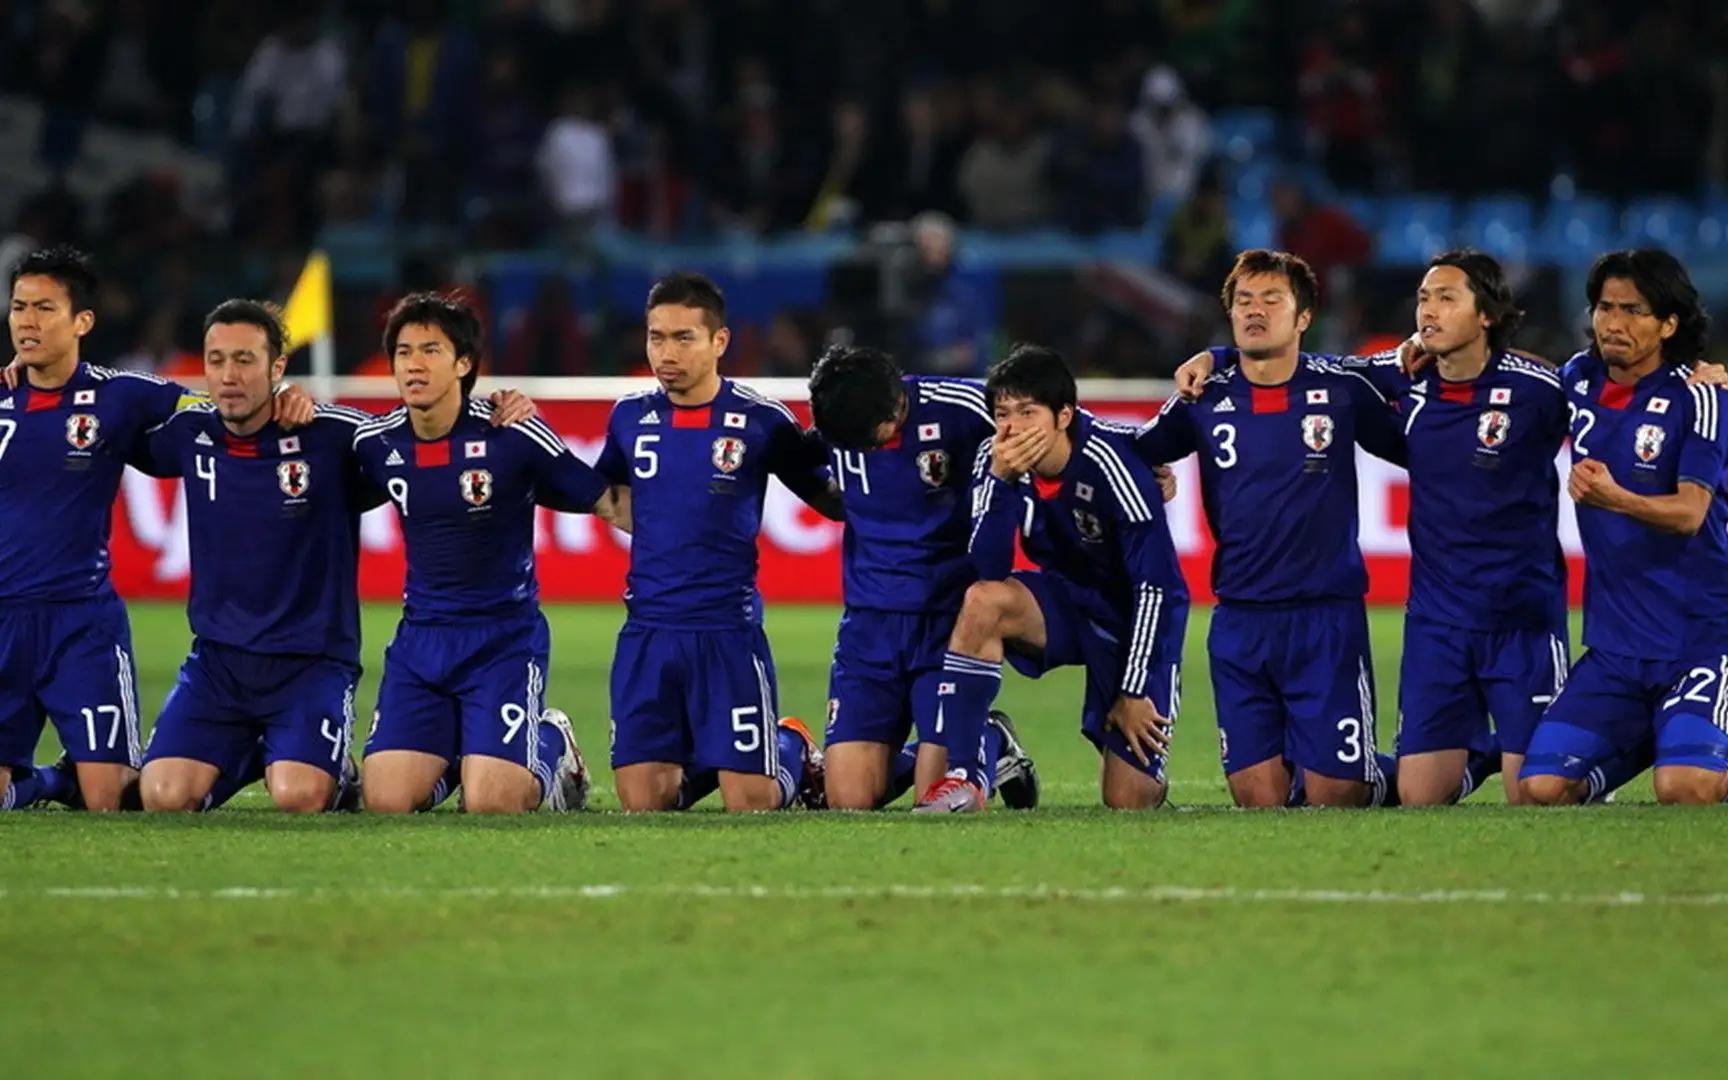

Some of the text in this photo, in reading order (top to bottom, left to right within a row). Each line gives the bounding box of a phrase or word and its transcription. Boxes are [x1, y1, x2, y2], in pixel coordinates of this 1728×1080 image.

[1405, 392, 1427, 436] 7
[634, 434, 661, 480] 5
[1212, 423, 1237, 469] 3
[196, 454, 216, 501] 4
[832, 447, 870, 495] 14
[387, 477, 409, 518] 9
[80, 704, 121, 751] 17
[320, 718, 343, 763] 4
[500, 703, 526, 745] 9
[731, 705, 760, 752] 5
[1336, 717, 1361, 763] 3
